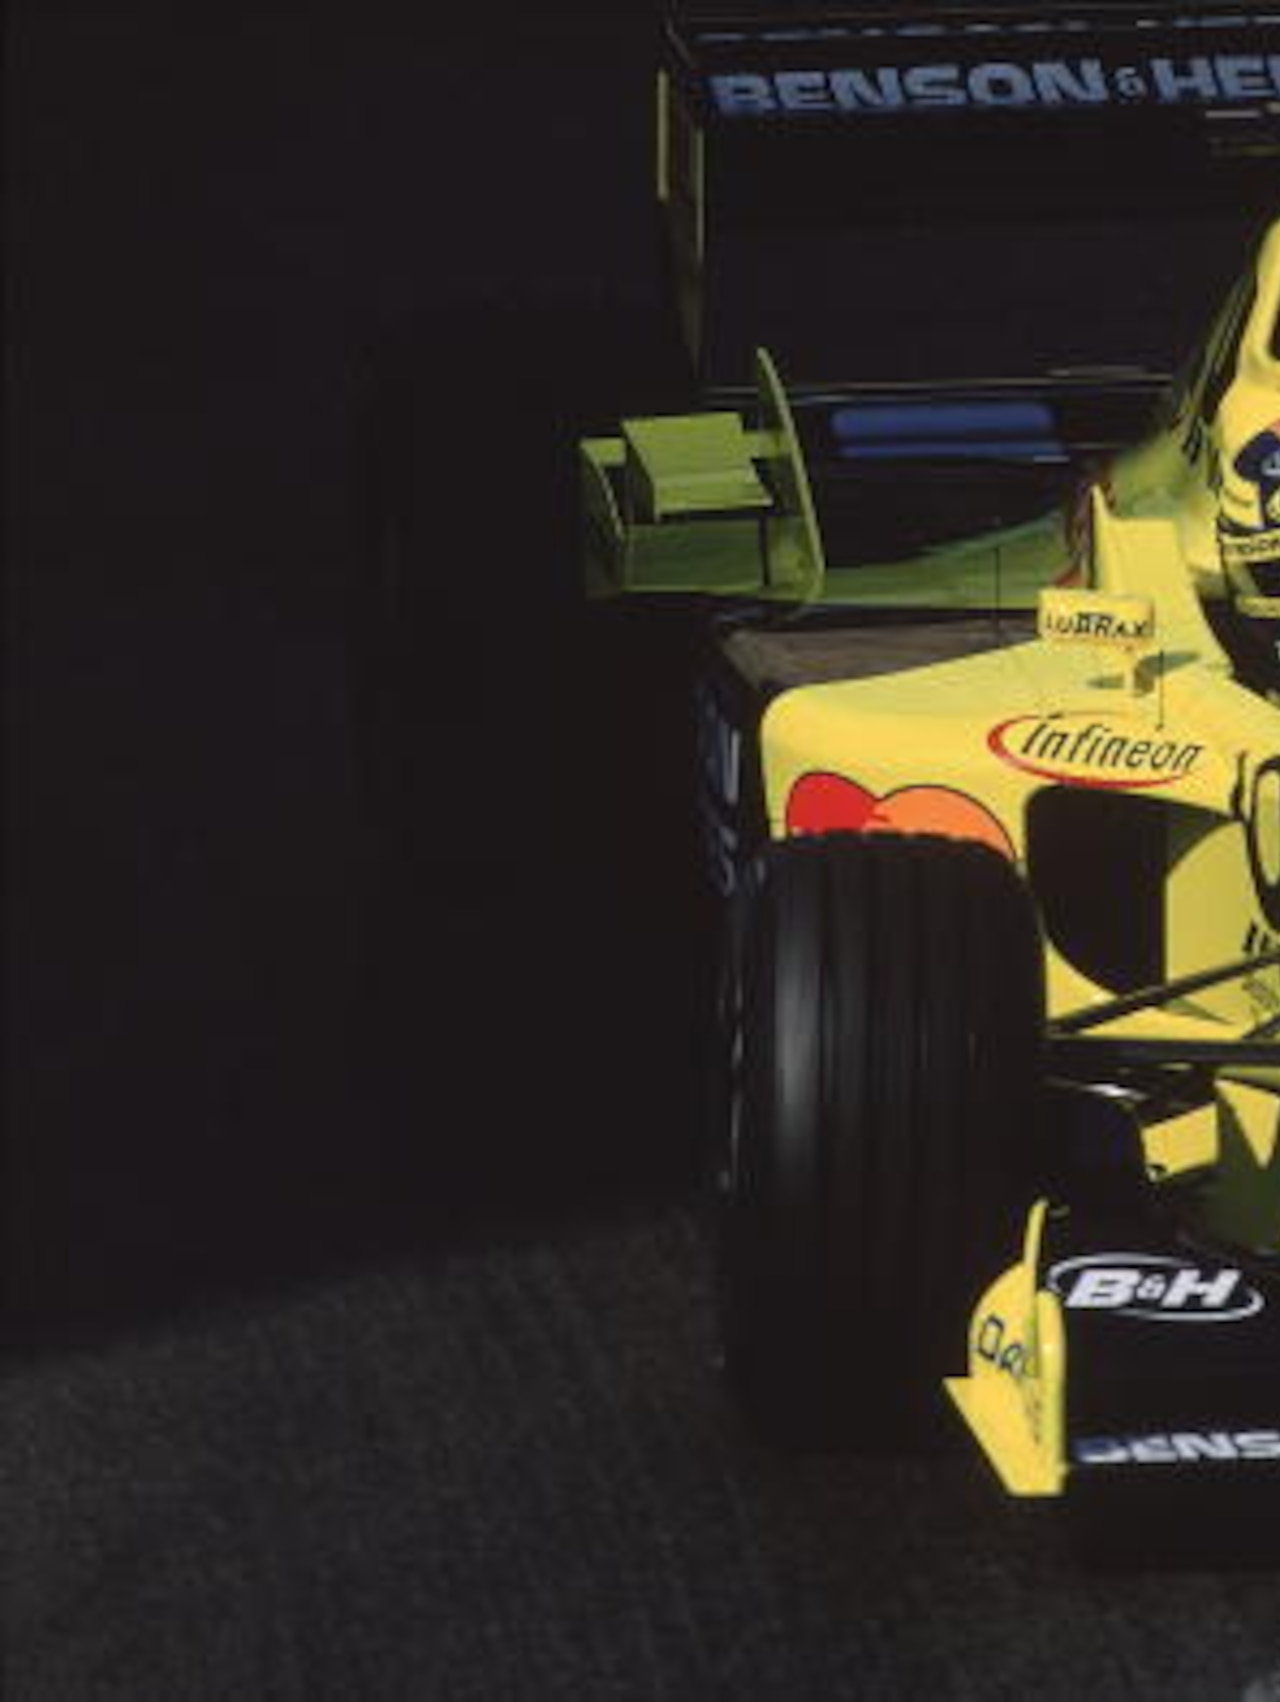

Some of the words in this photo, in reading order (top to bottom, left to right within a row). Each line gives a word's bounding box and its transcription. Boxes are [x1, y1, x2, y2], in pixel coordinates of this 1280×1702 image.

[708, 57, 1110, 113] BENSON
[1021, 721, 1204, 773] Infineon
[1065, 1269, 1239, 1308] B&H
